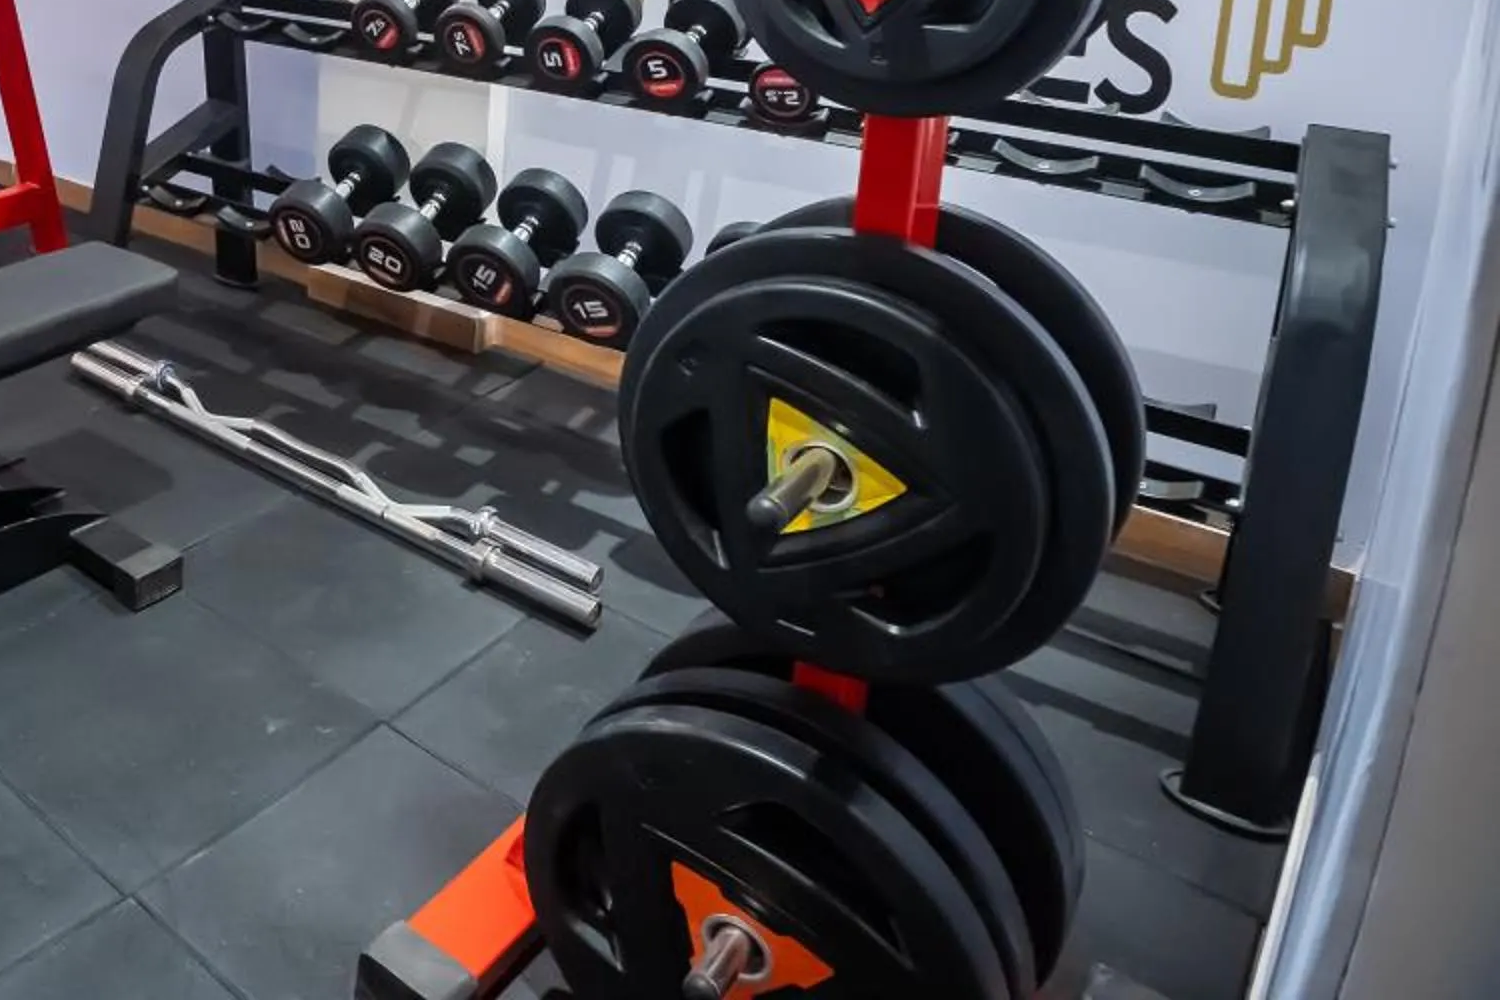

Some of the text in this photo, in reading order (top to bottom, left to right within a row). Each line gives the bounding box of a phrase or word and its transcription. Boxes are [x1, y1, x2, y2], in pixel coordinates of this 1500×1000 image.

[543, 53, 563, 68] 5
[647, 60, 668, 79] 5
[289, 219, 311, 249] 20
[368, 246, 402, 274] 20
[472, 264, 497, 291] 15
[573, 300, 609, 319] 15
